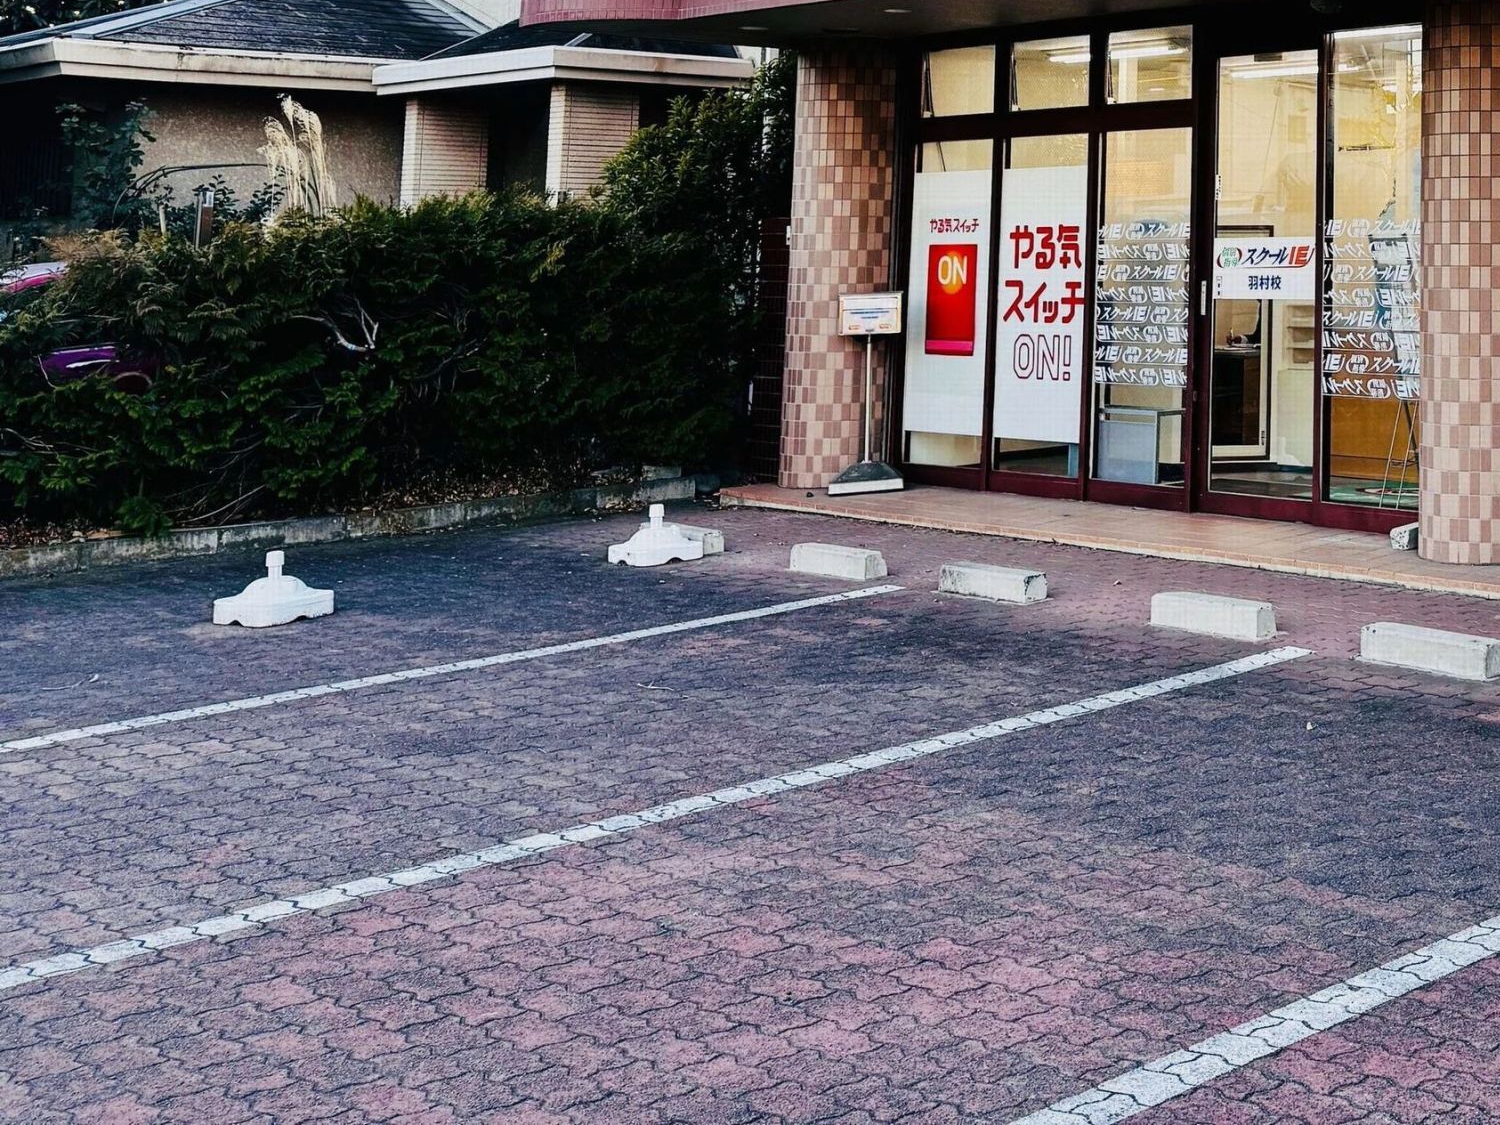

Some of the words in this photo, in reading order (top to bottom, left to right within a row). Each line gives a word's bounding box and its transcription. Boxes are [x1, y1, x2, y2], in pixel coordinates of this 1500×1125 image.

[930, 218, 980, 234] やる気スイッチ
[1009, 225, 1082, 269] やる気
[1241, 246, 1310, 266] スクールIE
[938, 255, 968, 286] ON
[1249, 275, 1281, 290] 羽村校
[1003, 279, 1085, 324] スイッチ
[1013, 333, 1072, 382] ON!
